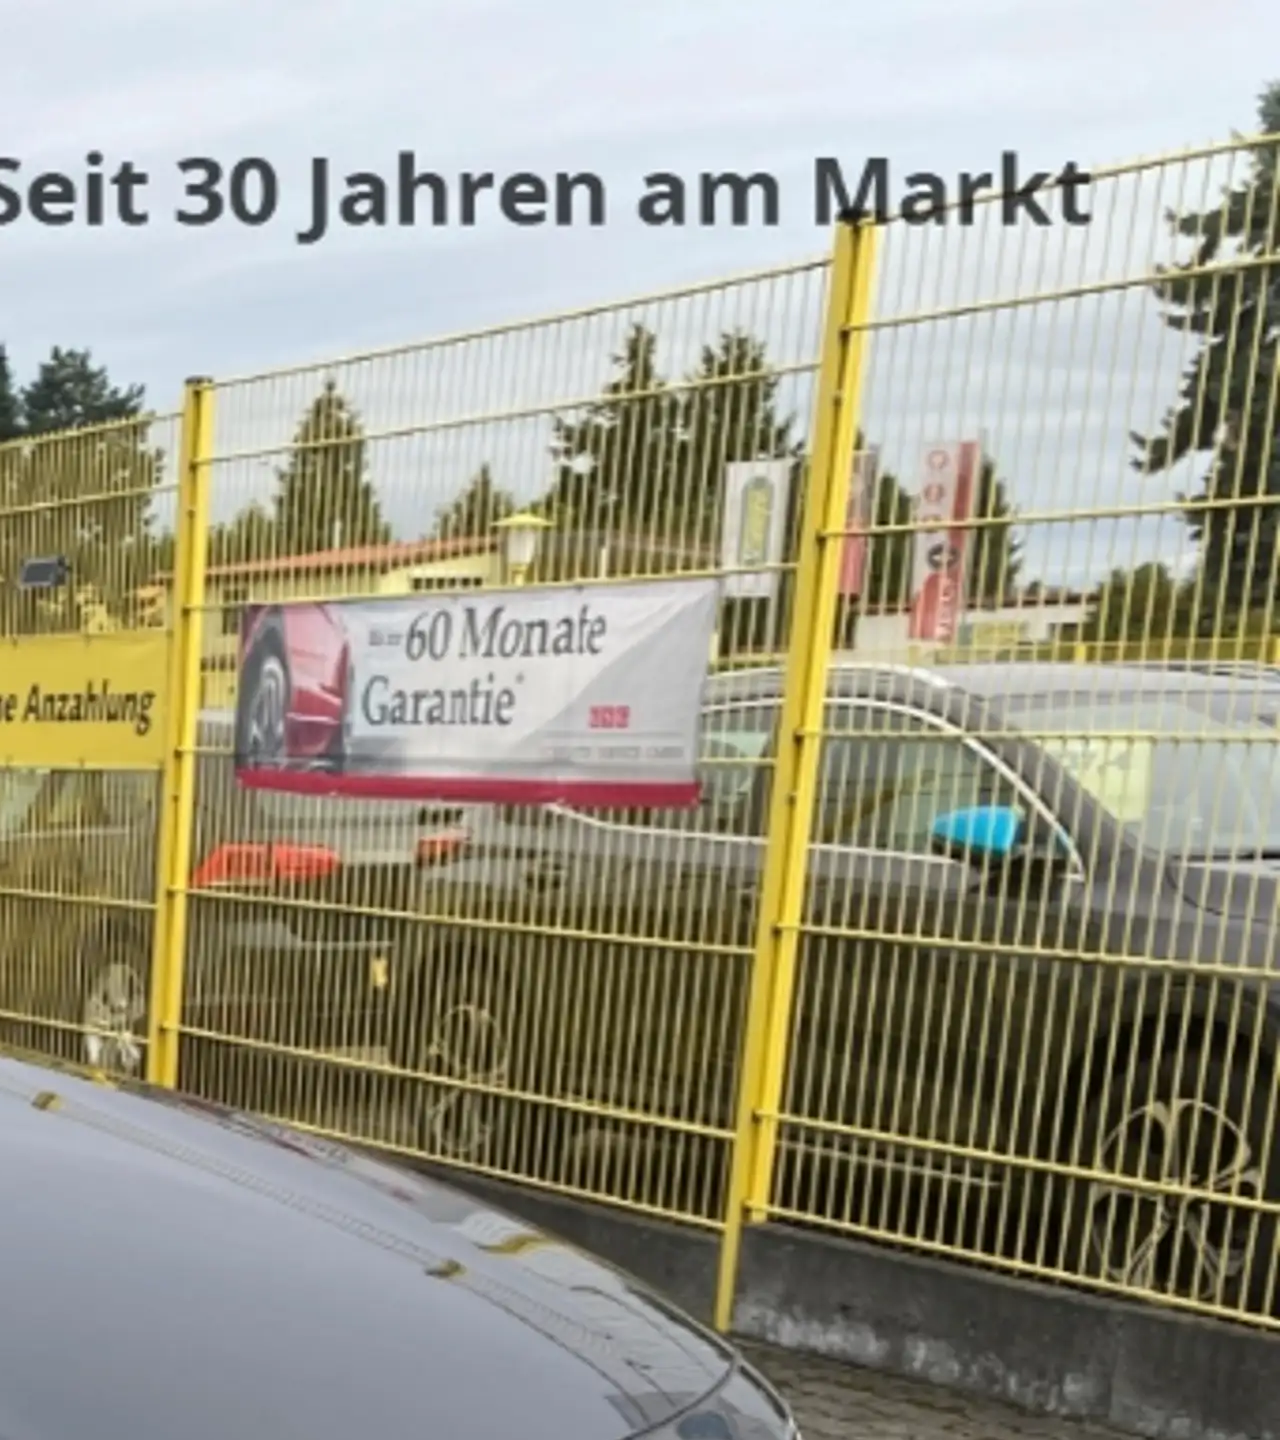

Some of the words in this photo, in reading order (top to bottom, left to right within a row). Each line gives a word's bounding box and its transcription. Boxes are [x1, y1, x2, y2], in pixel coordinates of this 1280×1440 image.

[405, 609, 455, 662] 60
[458, 603, 608, 659] Monate
[22, 678, 157, 737] Anzahlung
